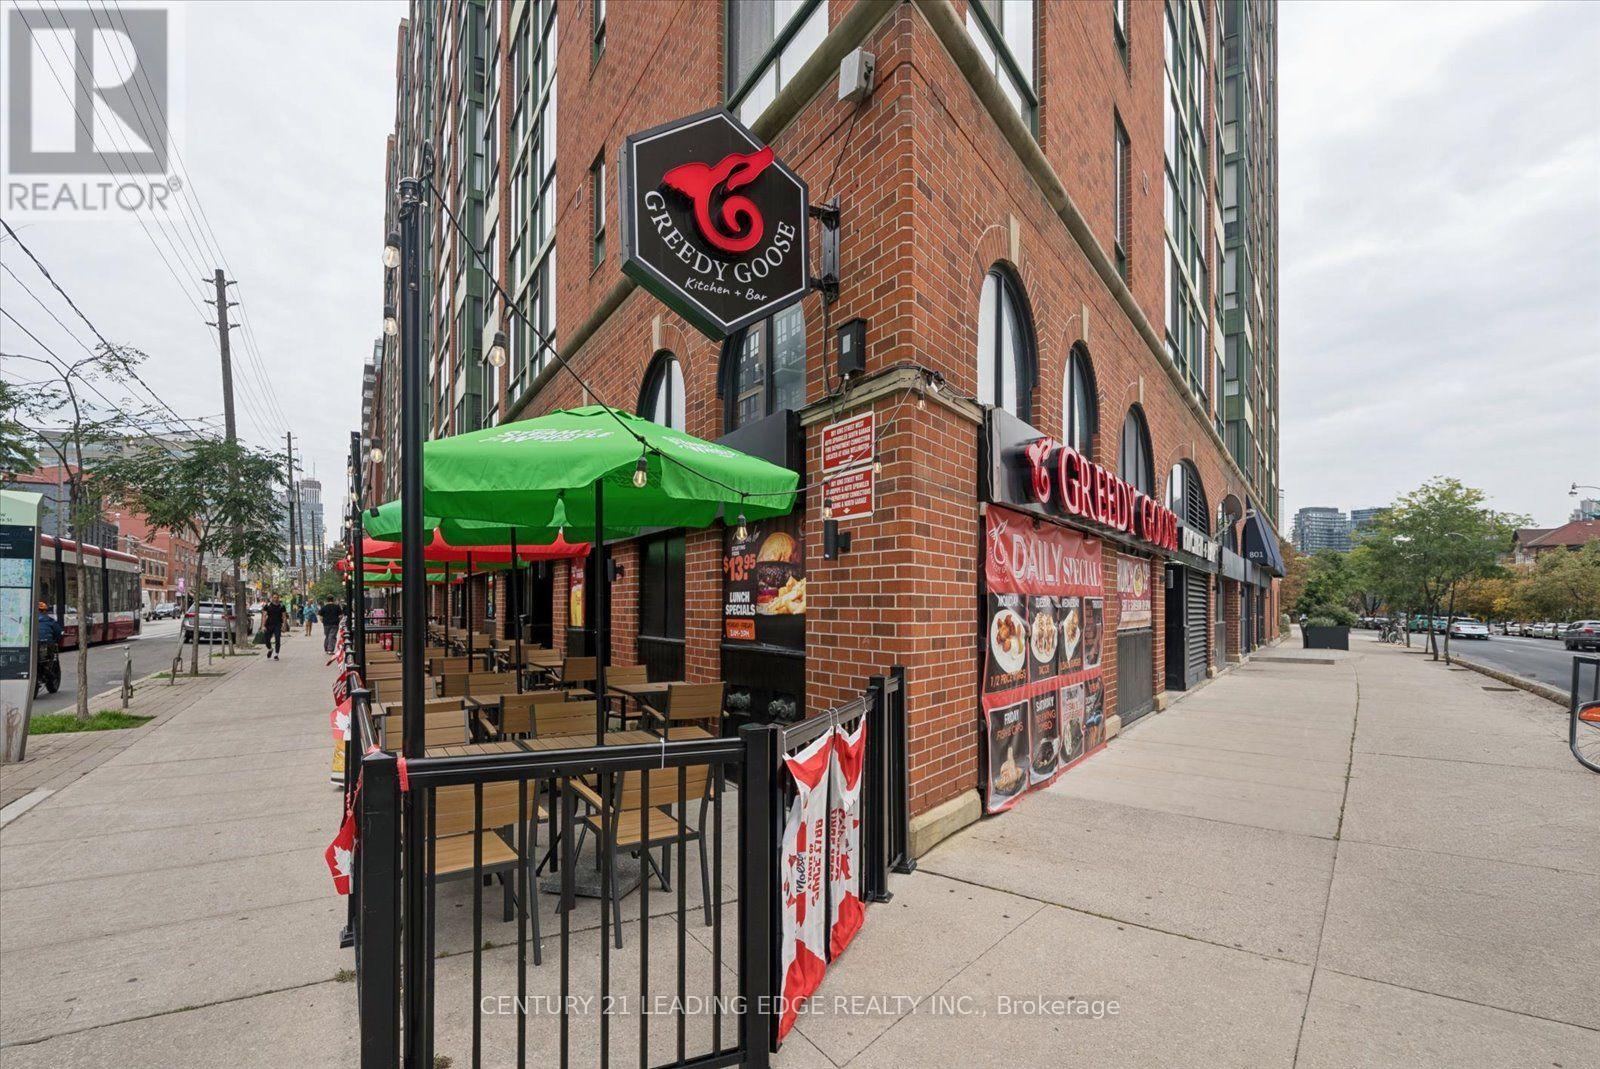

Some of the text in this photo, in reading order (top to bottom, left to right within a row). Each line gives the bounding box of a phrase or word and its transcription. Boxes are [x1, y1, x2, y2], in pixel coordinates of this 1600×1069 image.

[644, 190, 796, 284] GREEDY GOOSE
[684, 277, 730, 295] Kitchen
[746, 288, 768, 301] Bar
[1058, 446, 1136, 536] GREEDY
[1012, 533, 1062, 585] DAILY
[1249, 551, 1264, 559] 801
[730, 591, 750, 603] LUNCH
[725, 604, 756, 616] SPECIALS
